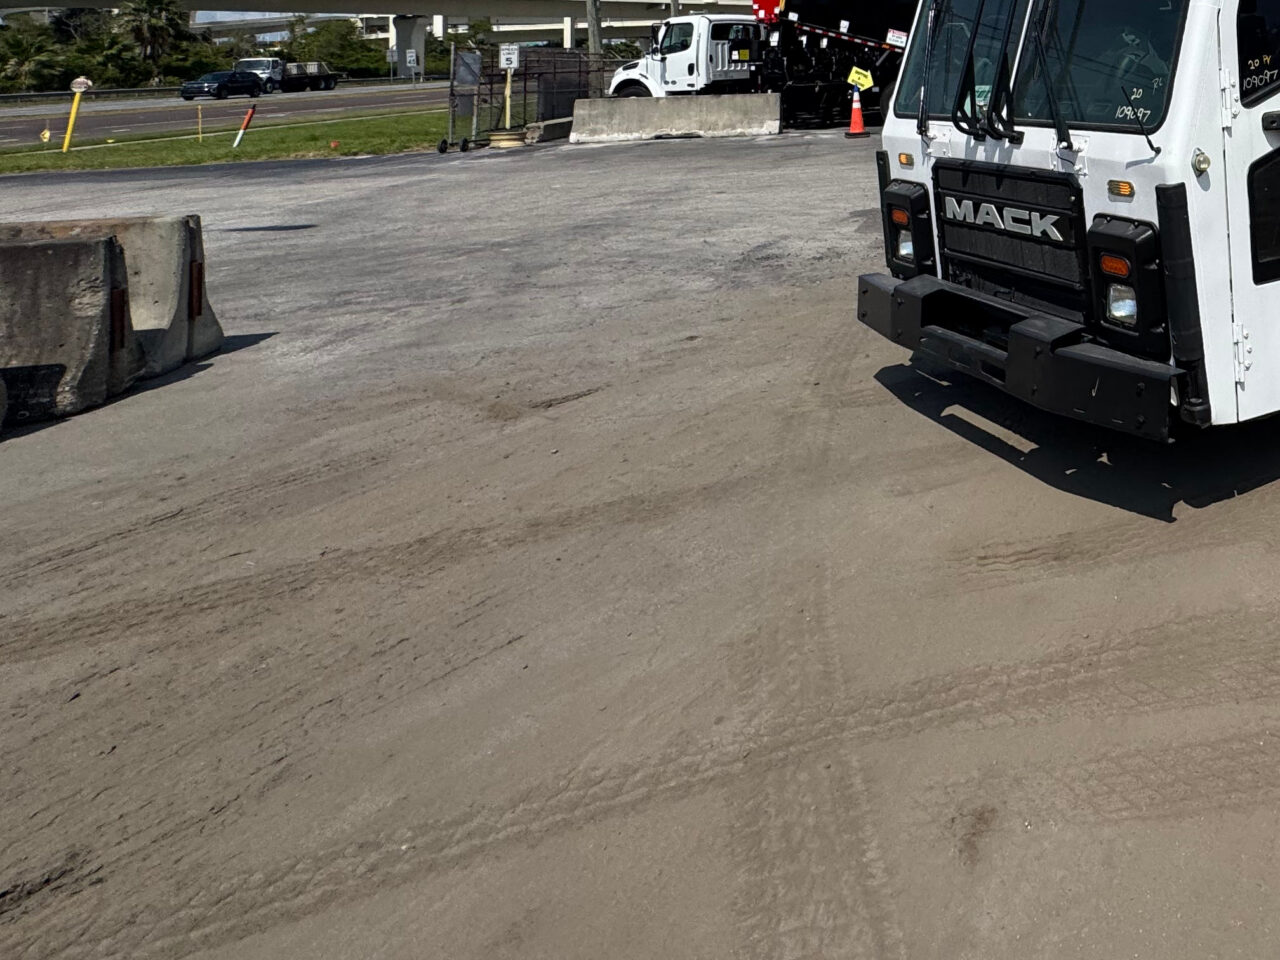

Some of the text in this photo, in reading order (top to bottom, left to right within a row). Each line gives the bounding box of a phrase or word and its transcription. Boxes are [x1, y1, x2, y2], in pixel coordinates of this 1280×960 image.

[505, 57, 513, 66] 5
[1247, 58, 1260, 70] 20
[1243, 69, 1279, 91] 109097
[1130, 87, 1143, 100] 20
[945, 196, 1063, 241] MACK
